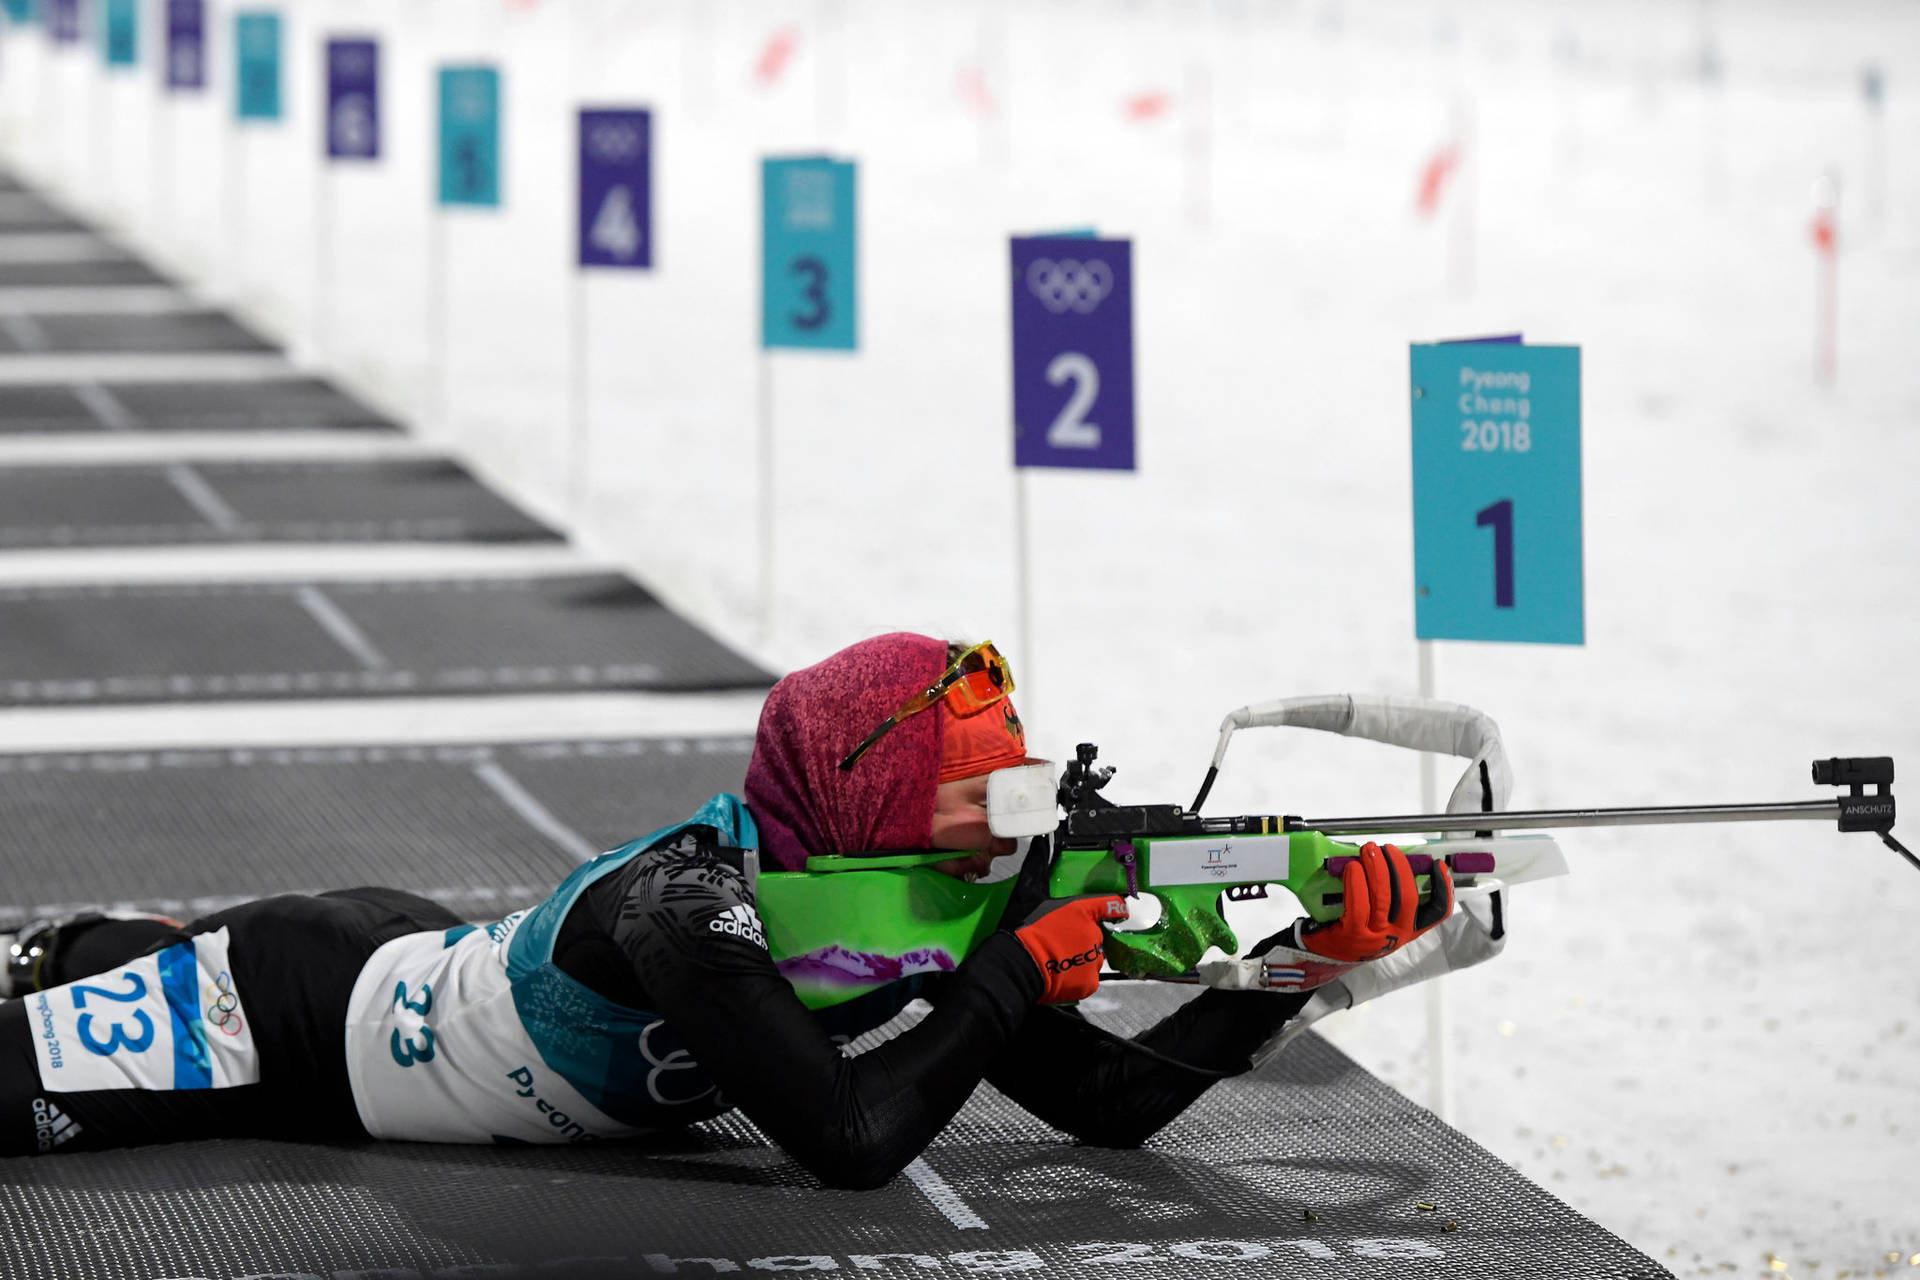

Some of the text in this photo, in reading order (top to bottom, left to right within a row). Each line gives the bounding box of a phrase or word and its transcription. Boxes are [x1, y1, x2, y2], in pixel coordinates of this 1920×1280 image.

[589, 184, 642, 261] 4
[789, 256, 831, 332] 3
[1046, 352, 1102, 449] 2
[1459, 393, 1530, 419] Chang
[1460, 367, 1530, 394] Pyeong
[1461, 420, 1531, 452] 2018
[1476, 499, 1514, 608] 1
[70, 972, 154, 1057] 23
[391, 981, 435, 1068] 23
[47, 1040, 63, 1070] 2018
[540, 1250, 1046, 1276] hang
[1068, 1239, 1448, 1264] 2018
